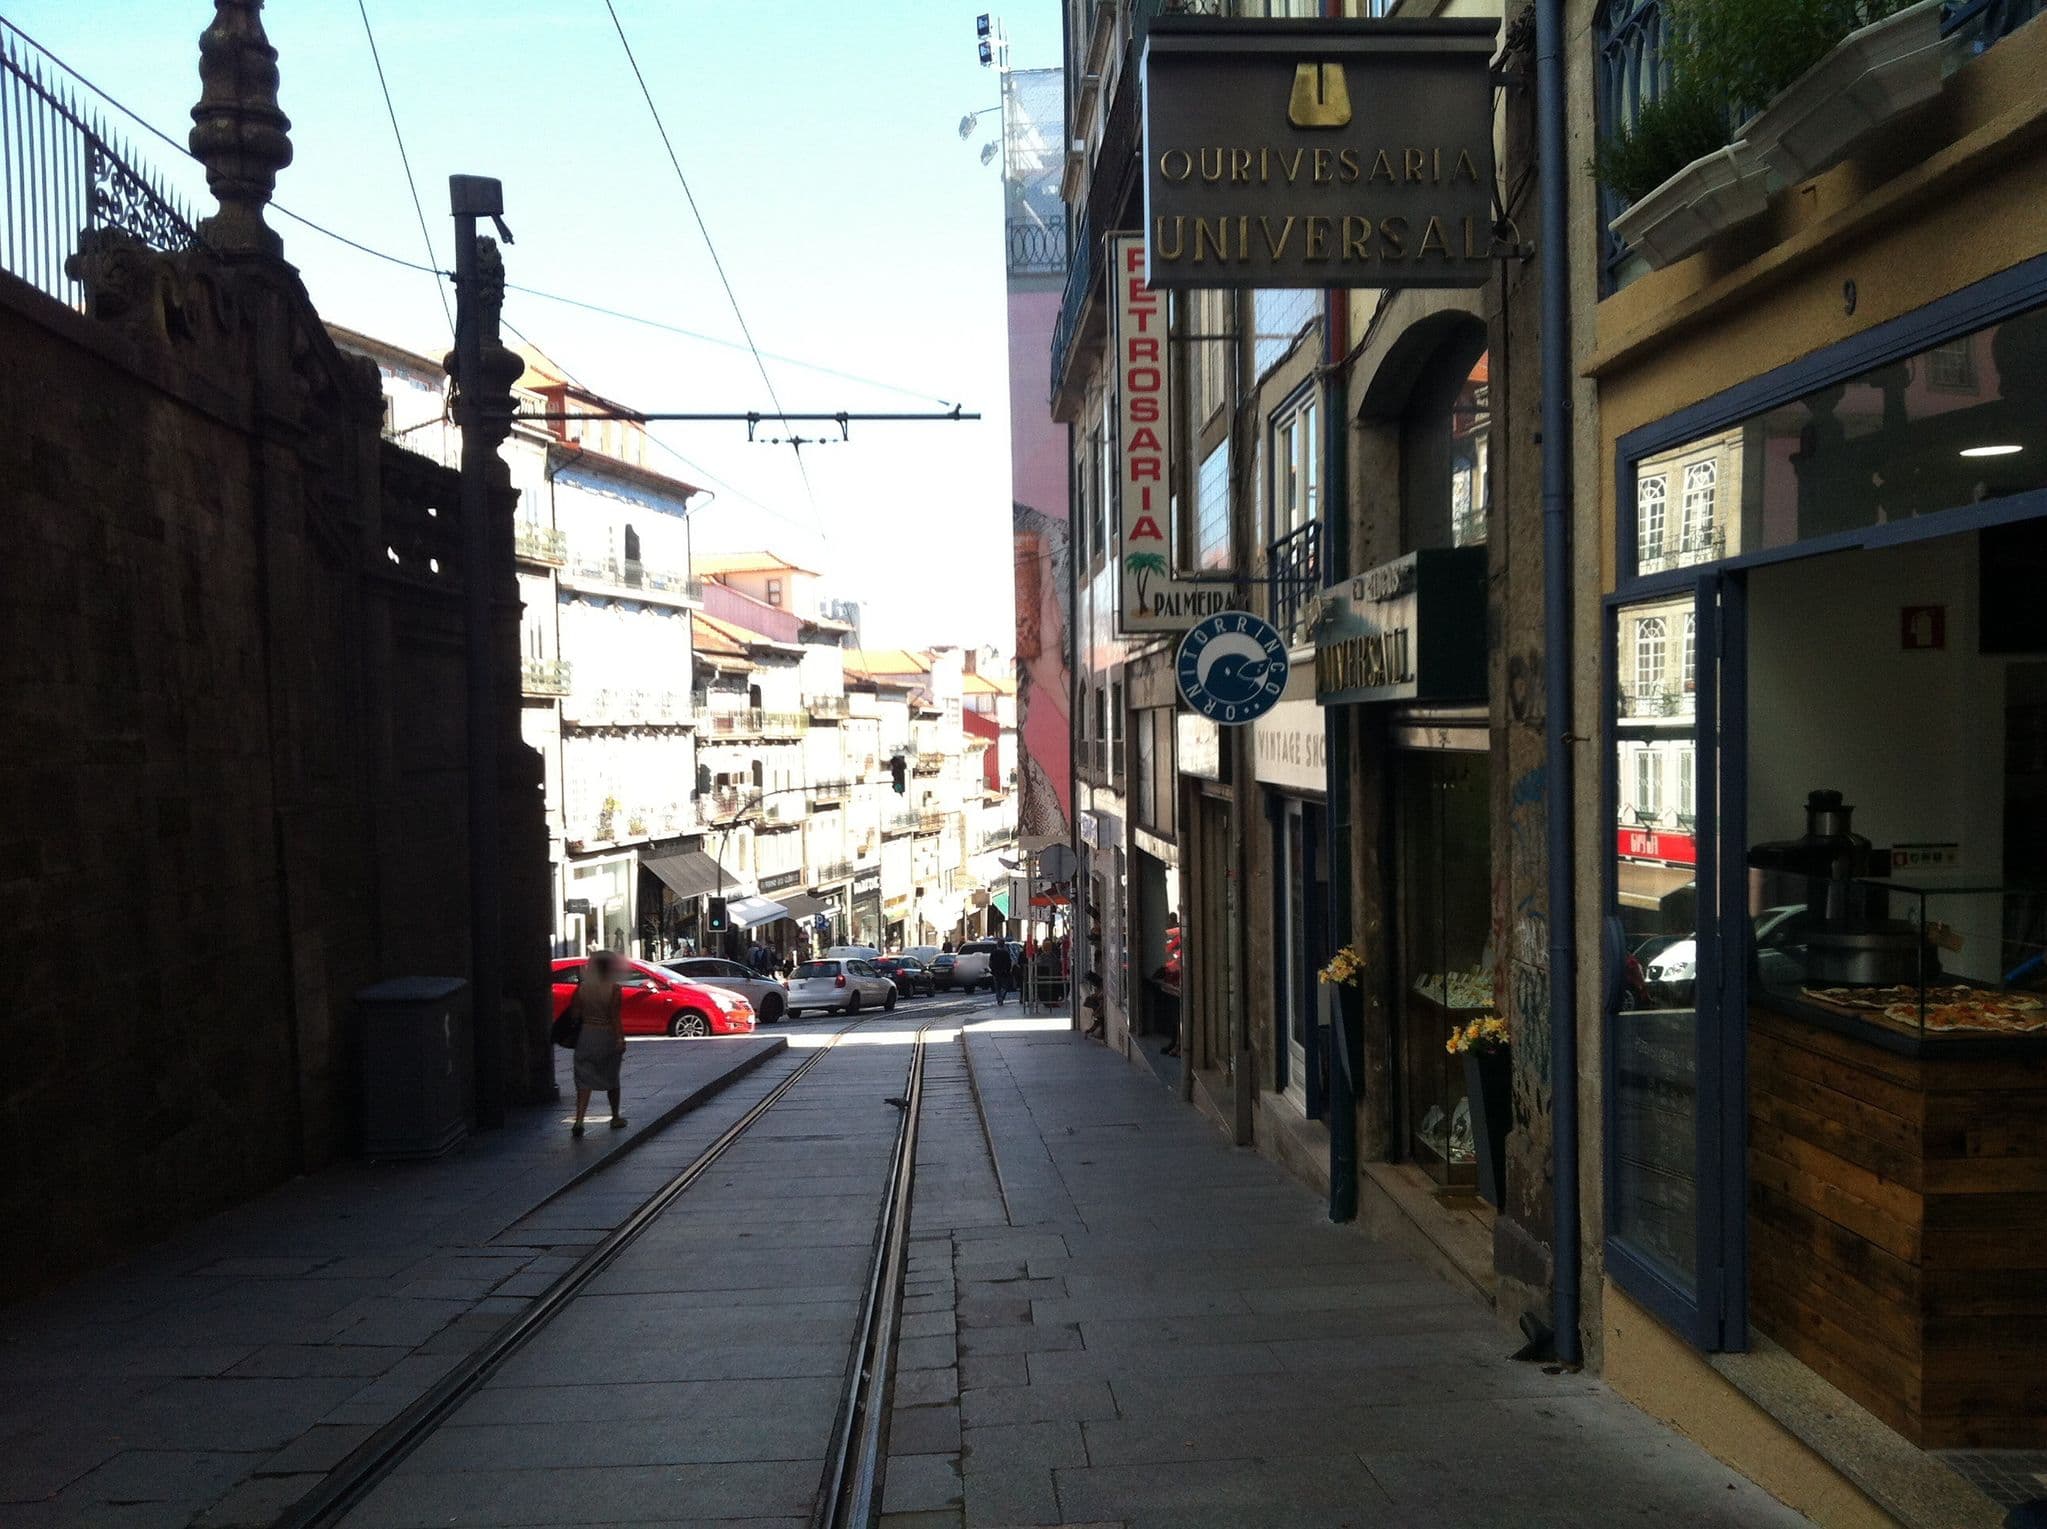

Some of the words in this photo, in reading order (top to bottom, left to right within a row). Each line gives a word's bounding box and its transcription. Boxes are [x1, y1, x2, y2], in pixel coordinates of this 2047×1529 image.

[1161, 147, 1480, 182] OURIVESARIA
[1156, 216, 1491, 261] UNIVERSAL
[1258, 729, 1301, 766] VINTAGE
